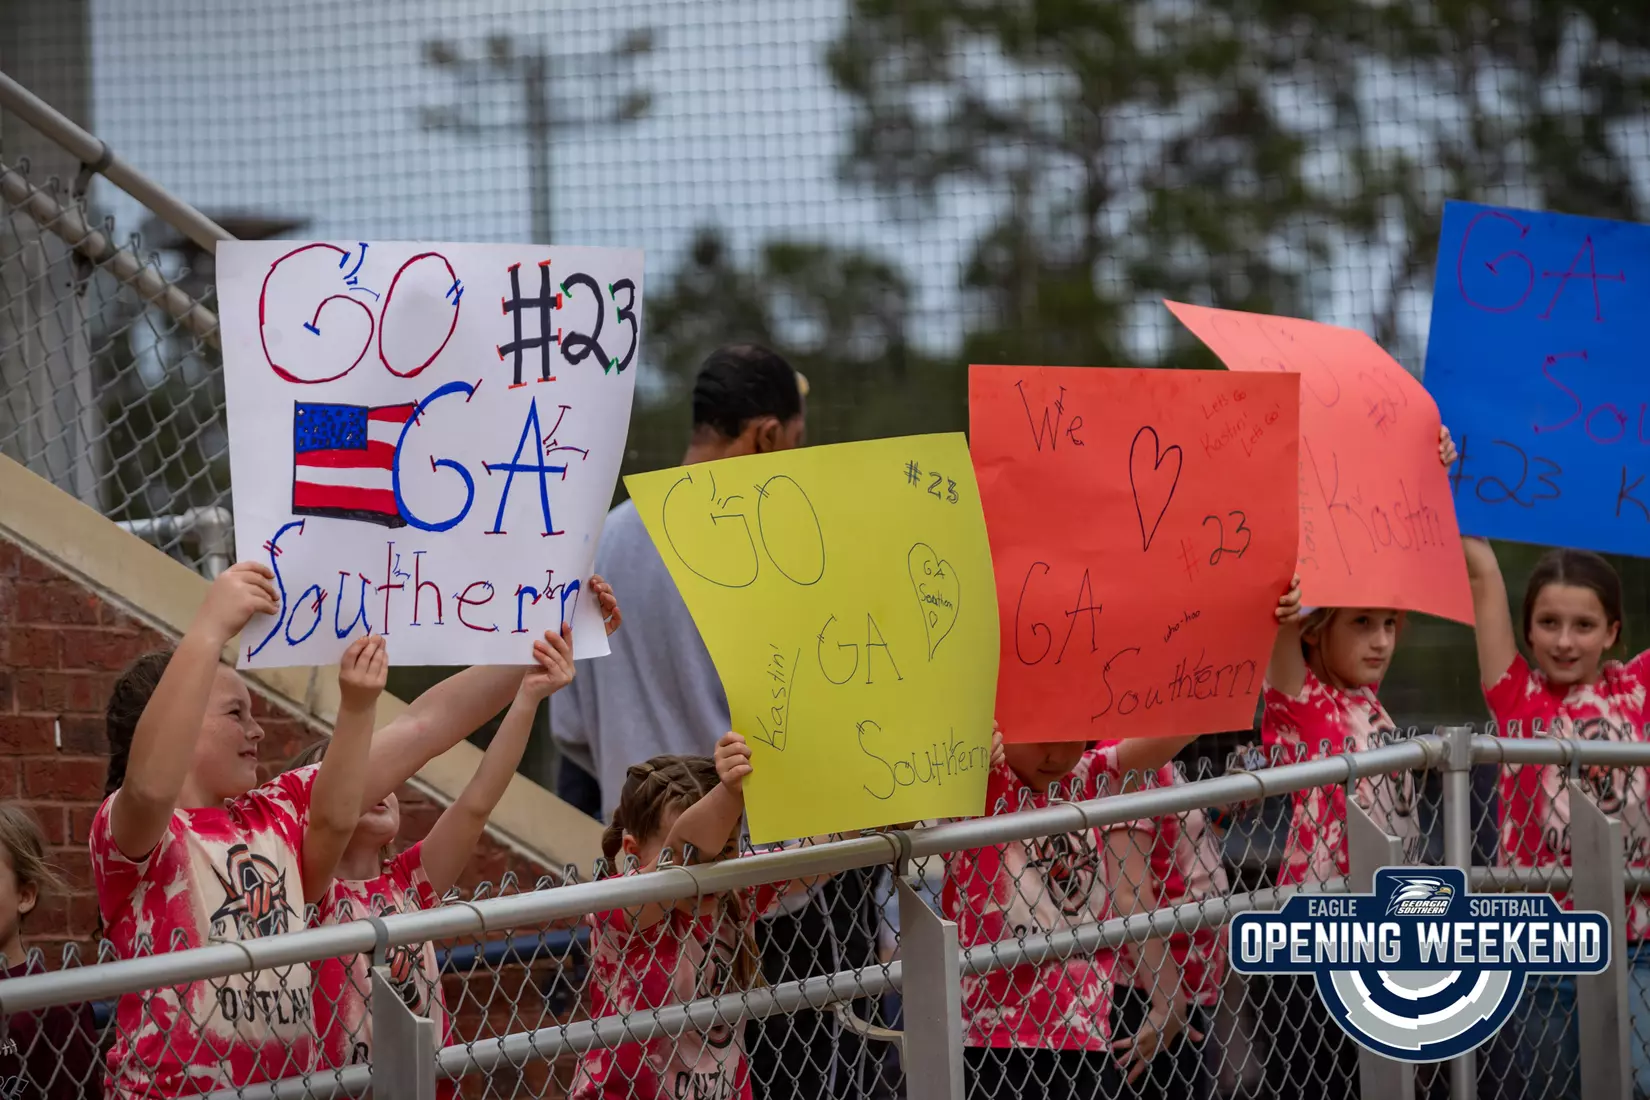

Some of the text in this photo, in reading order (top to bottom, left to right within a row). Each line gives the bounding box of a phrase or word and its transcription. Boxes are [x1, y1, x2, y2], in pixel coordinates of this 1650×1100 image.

[259, 243, 464, 384] GO
[1457, 211, 1626, 322] GA
[497, 259, 638, 389] #23
[392, 379, 568, 536] GA
[1015, 380, 1085, 452] We
[663, 472, 825, 588] GO
[903, 459, 959, 504] #23
[247, 518, 583, 662] Southern
[924, 560, 946, 579] GA
[1015, 561, 1103, 665] GA
[817, 612, 904, 685] GA
[1091, 648, 1257, 722] Southern
[856, 720, 988, 800] Southern
